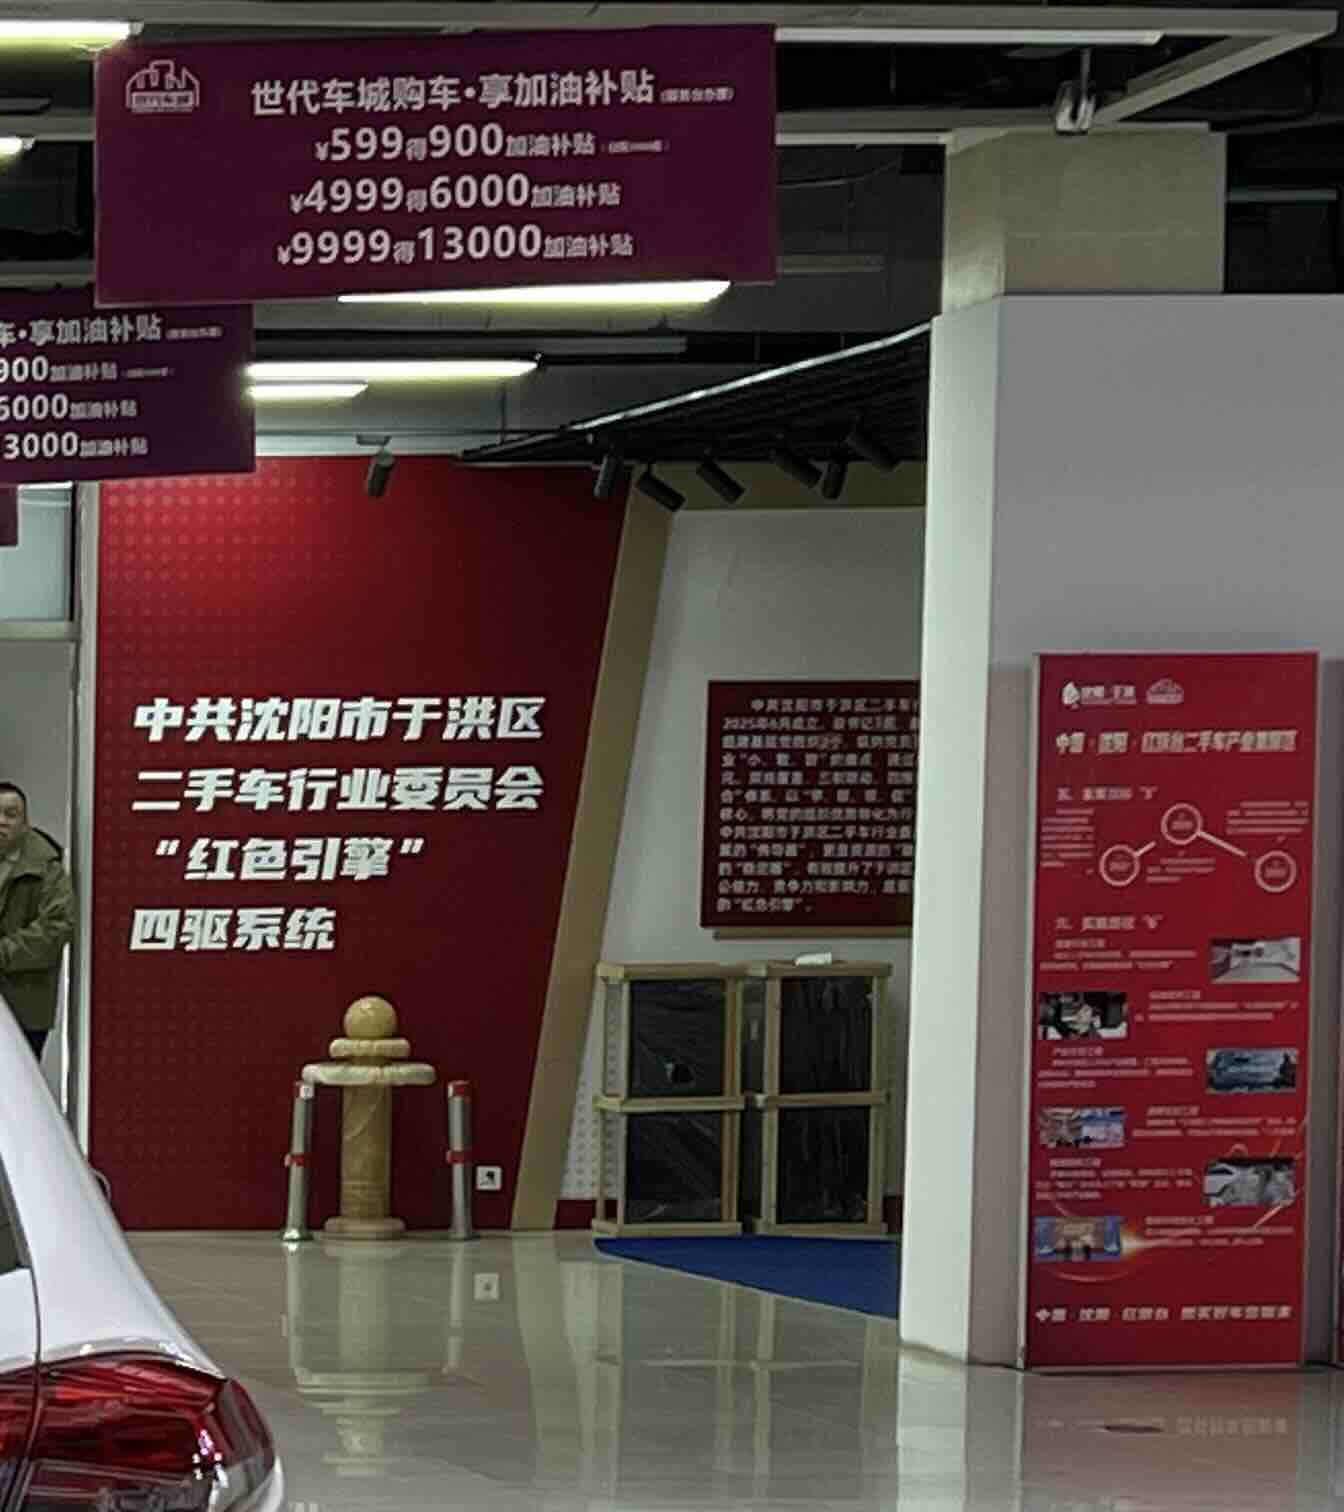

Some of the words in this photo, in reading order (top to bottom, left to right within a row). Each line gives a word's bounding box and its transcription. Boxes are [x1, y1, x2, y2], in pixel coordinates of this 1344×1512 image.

[132, 696, 546, 742] 中共沈阳市于洪区
[131, 765, 544, 812] 二手车行业委员会
[129, 907, 337, 952] 四驱系统
